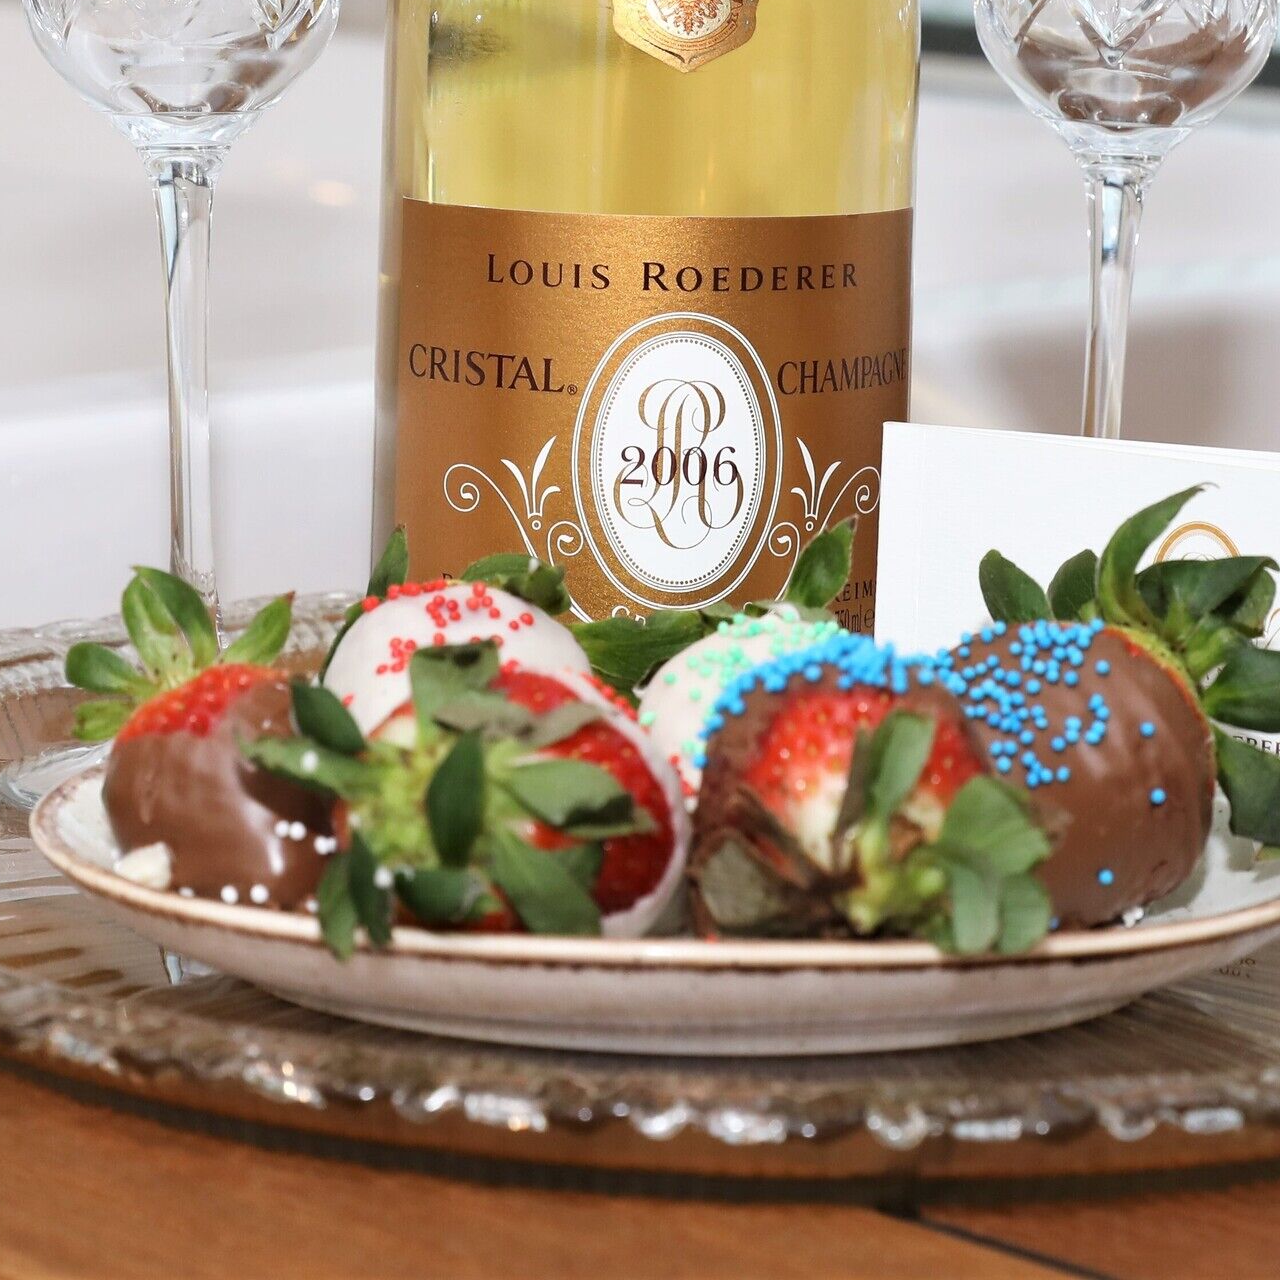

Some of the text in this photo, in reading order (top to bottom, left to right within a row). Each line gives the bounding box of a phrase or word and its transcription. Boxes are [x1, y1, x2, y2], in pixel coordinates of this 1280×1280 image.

[486, 253, 859, 293] LOUIS ROEDERER
[619, 445, 739, 488] 2006
[834, 579, 873, 603] EIM
